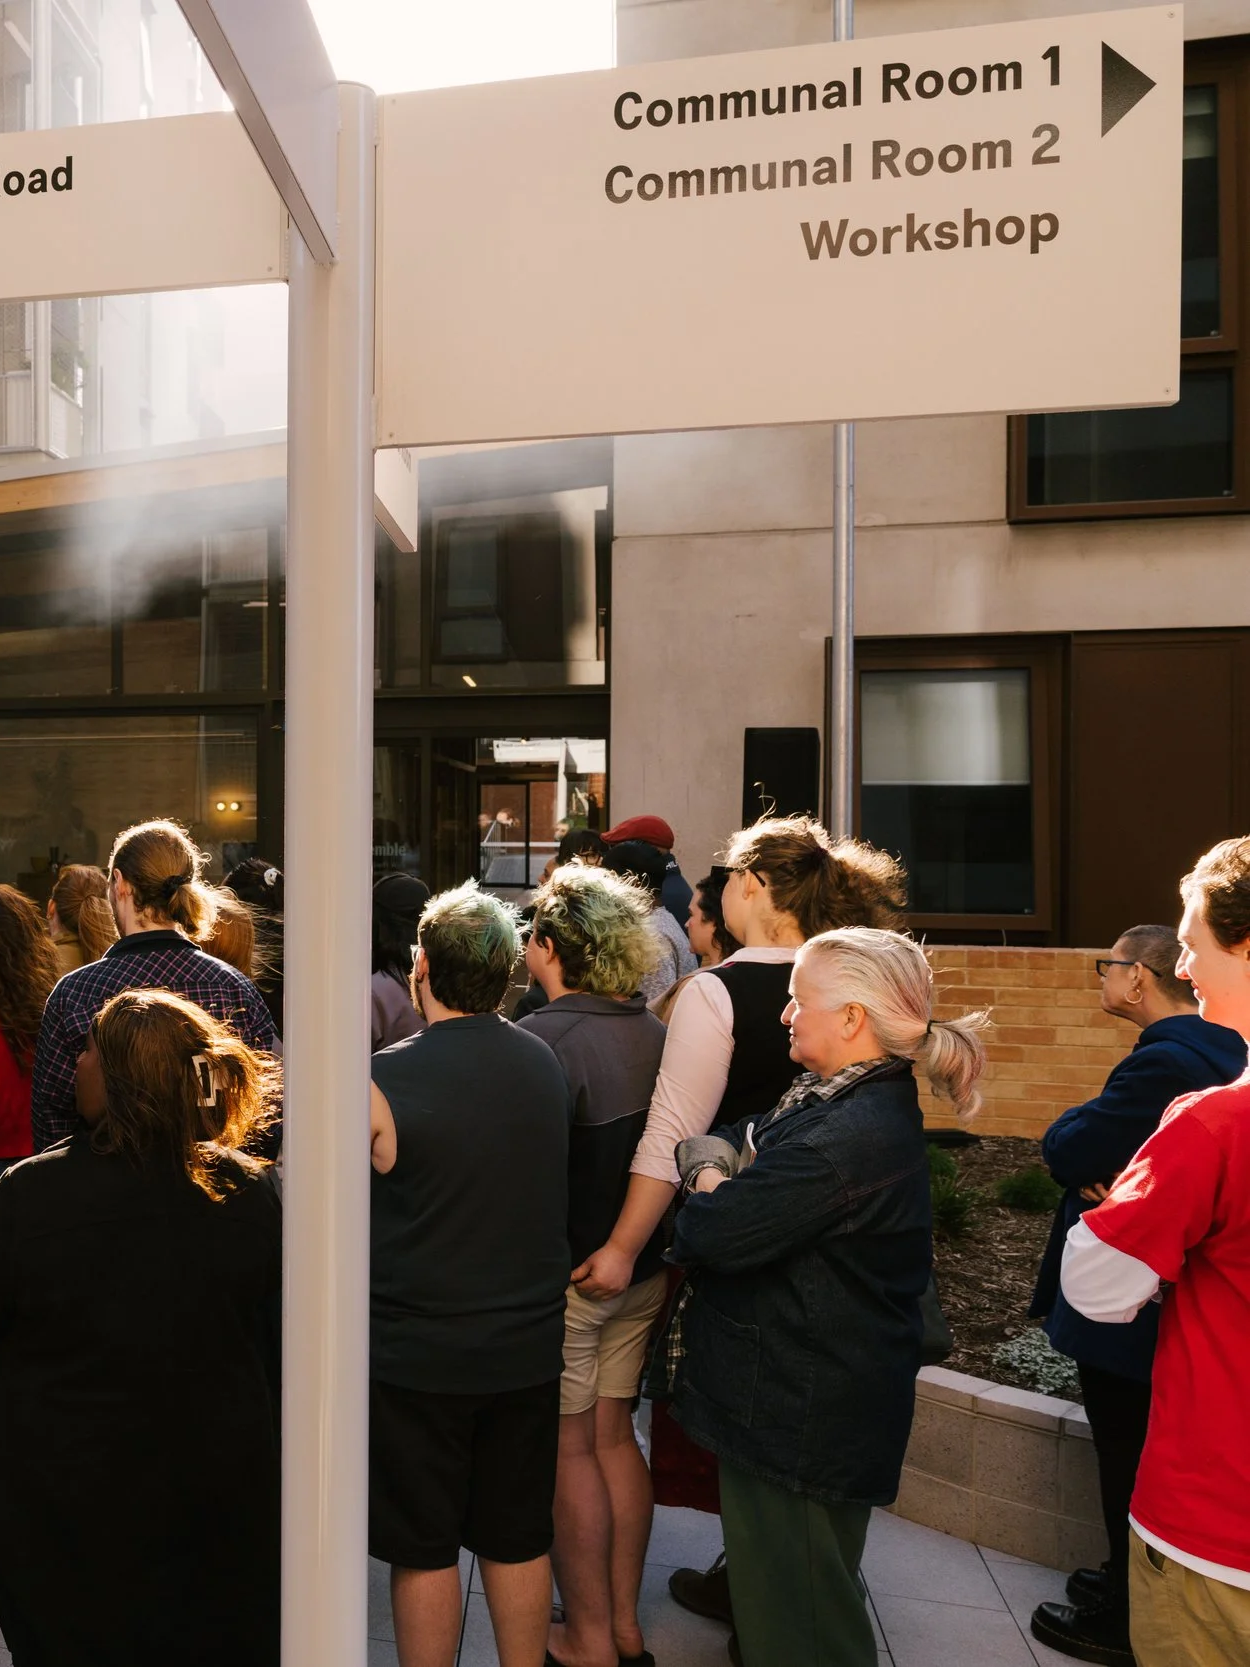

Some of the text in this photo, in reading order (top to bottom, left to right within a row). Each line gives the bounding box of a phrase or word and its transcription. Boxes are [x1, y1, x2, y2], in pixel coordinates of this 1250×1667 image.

[614, 45, 1061, 131] Communal Room 1
[605, 124, 1061, 205] Communal Room 2
[800, 208, 1060, 261] Workshop
